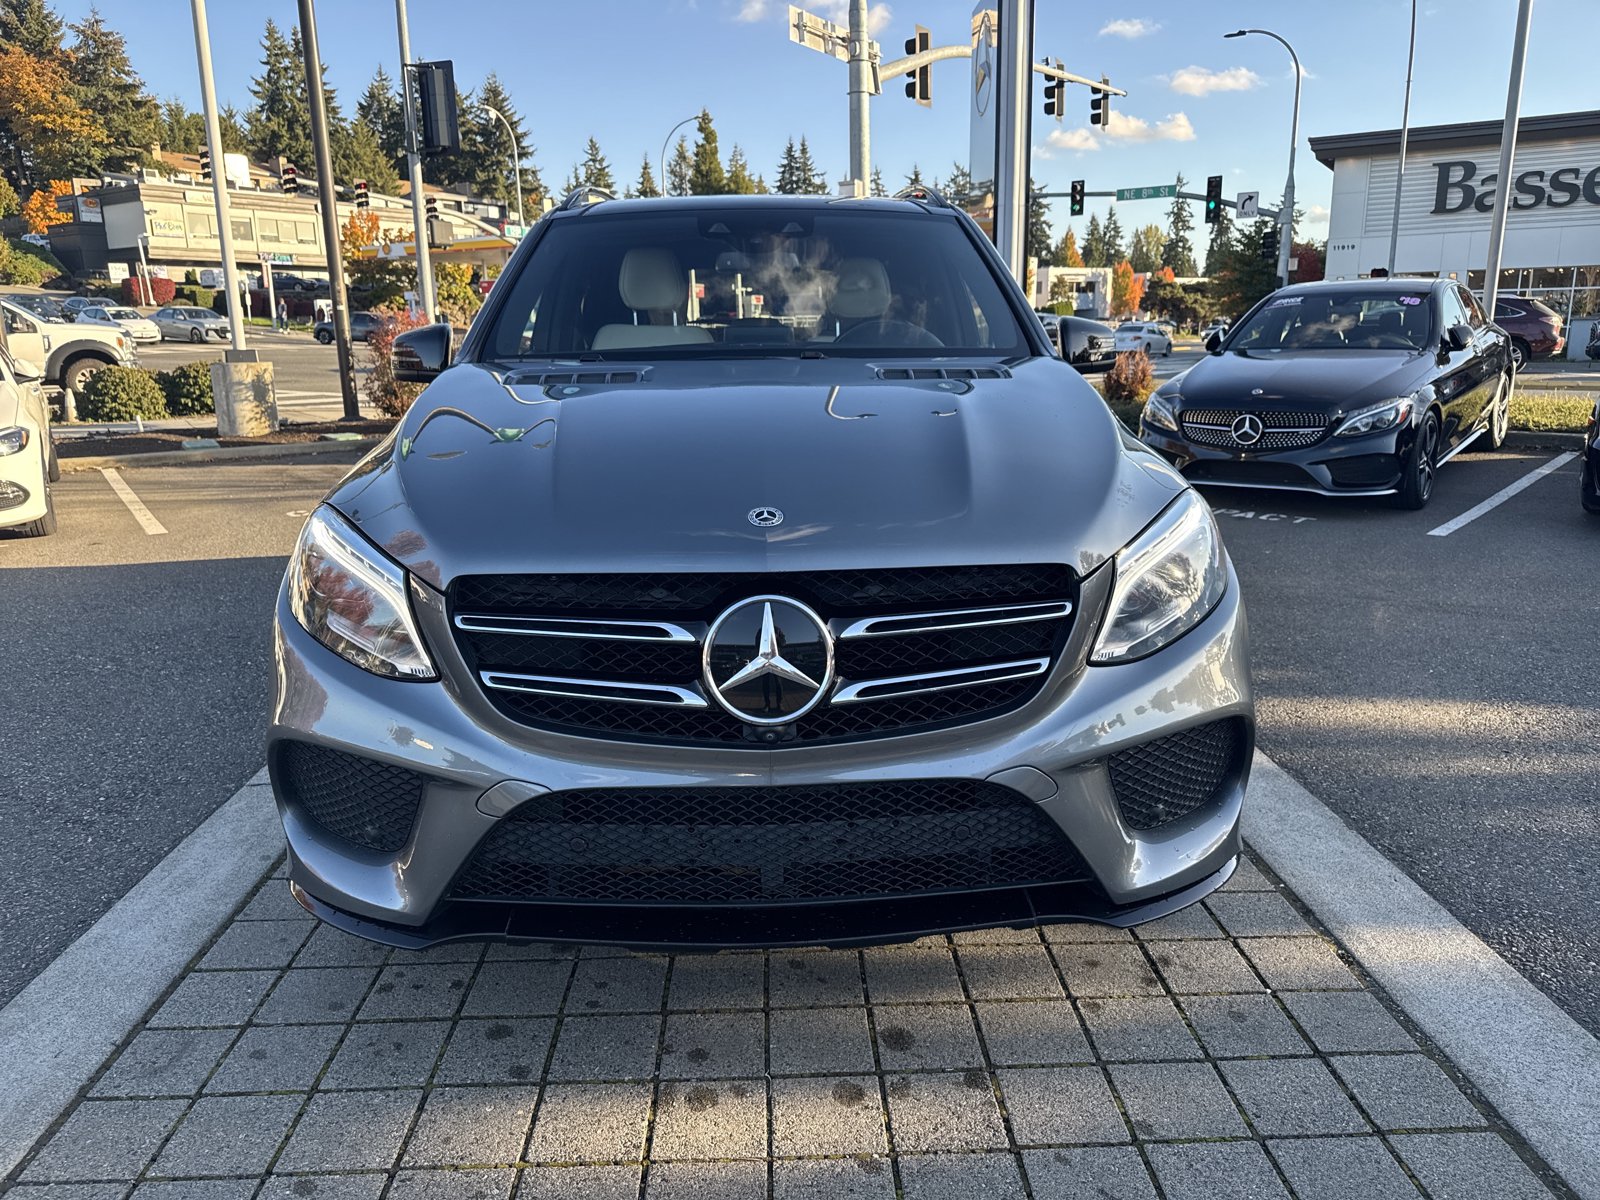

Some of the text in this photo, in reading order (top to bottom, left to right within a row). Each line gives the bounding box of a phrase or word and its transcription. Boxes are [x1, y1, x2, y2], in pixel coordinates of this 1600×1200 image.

[1123, 186, 1169, 200] NE 8th St
[1238, 209, 1256, 217] ONLY
[1211, 508, 1318, 524] PACT
